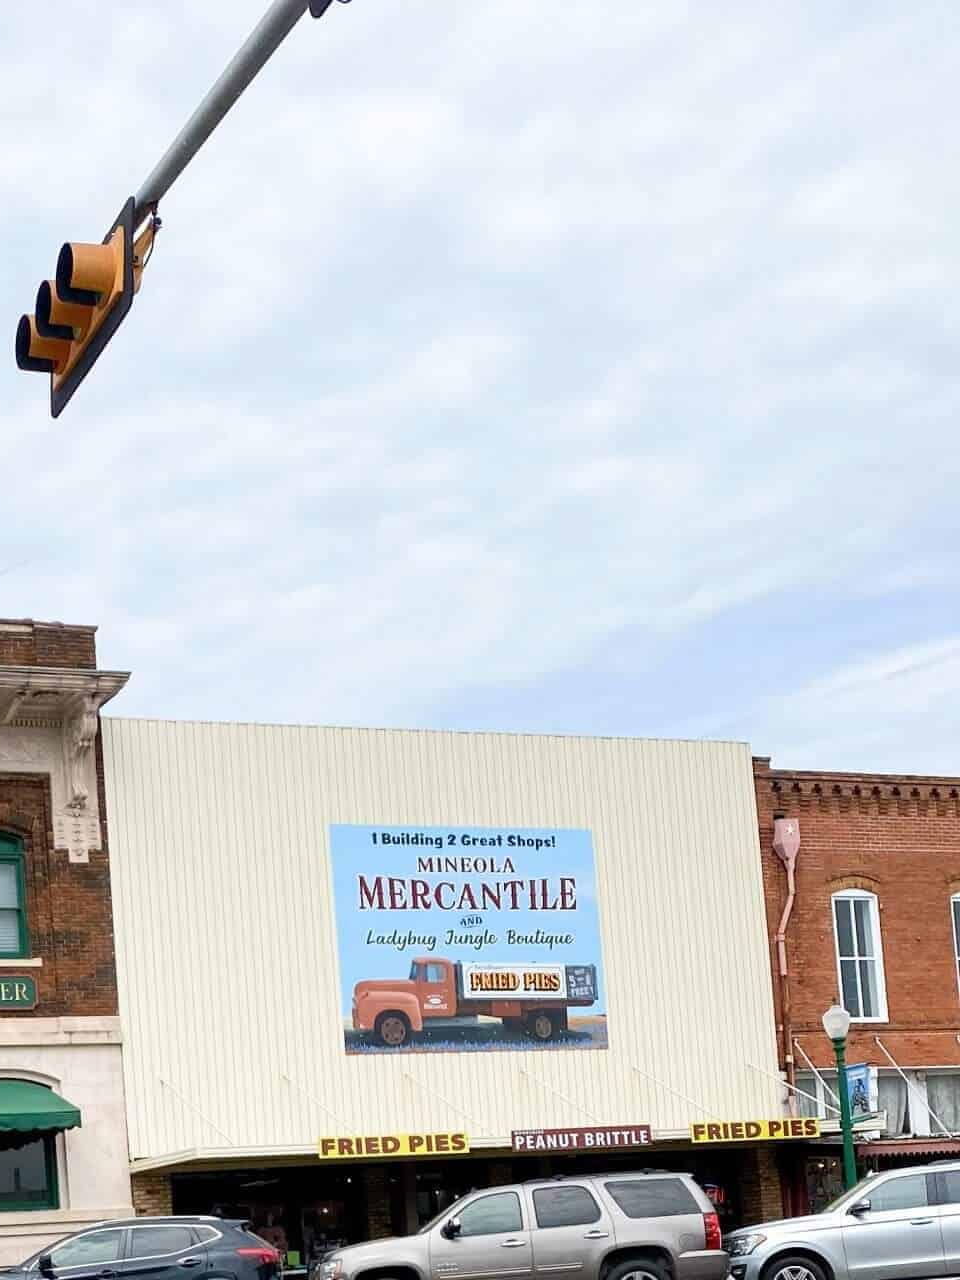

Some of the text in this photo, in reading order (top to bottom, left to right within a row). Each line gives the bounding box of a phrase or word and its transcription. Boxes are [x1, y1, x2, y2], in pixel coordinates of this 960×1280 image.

[371, 832, 556, 851] 1 Building 2 Great Shops!
[416, 856, 516, 873] MINEOLA
[358, 874, 577, 911] MERCANTILE
[459, 915, 483, 927] AND
[366, 929, 574, 950] Ladybug Jungle Boutique
[470, 972, 561, 992] FRIED PIES
[514, 1130, 650, 1150] PEANUT BRITTLE
[692, 1119, 818, 1141] FRIED PIES
[321, 1133, 466, 1156] FRIED PIES
